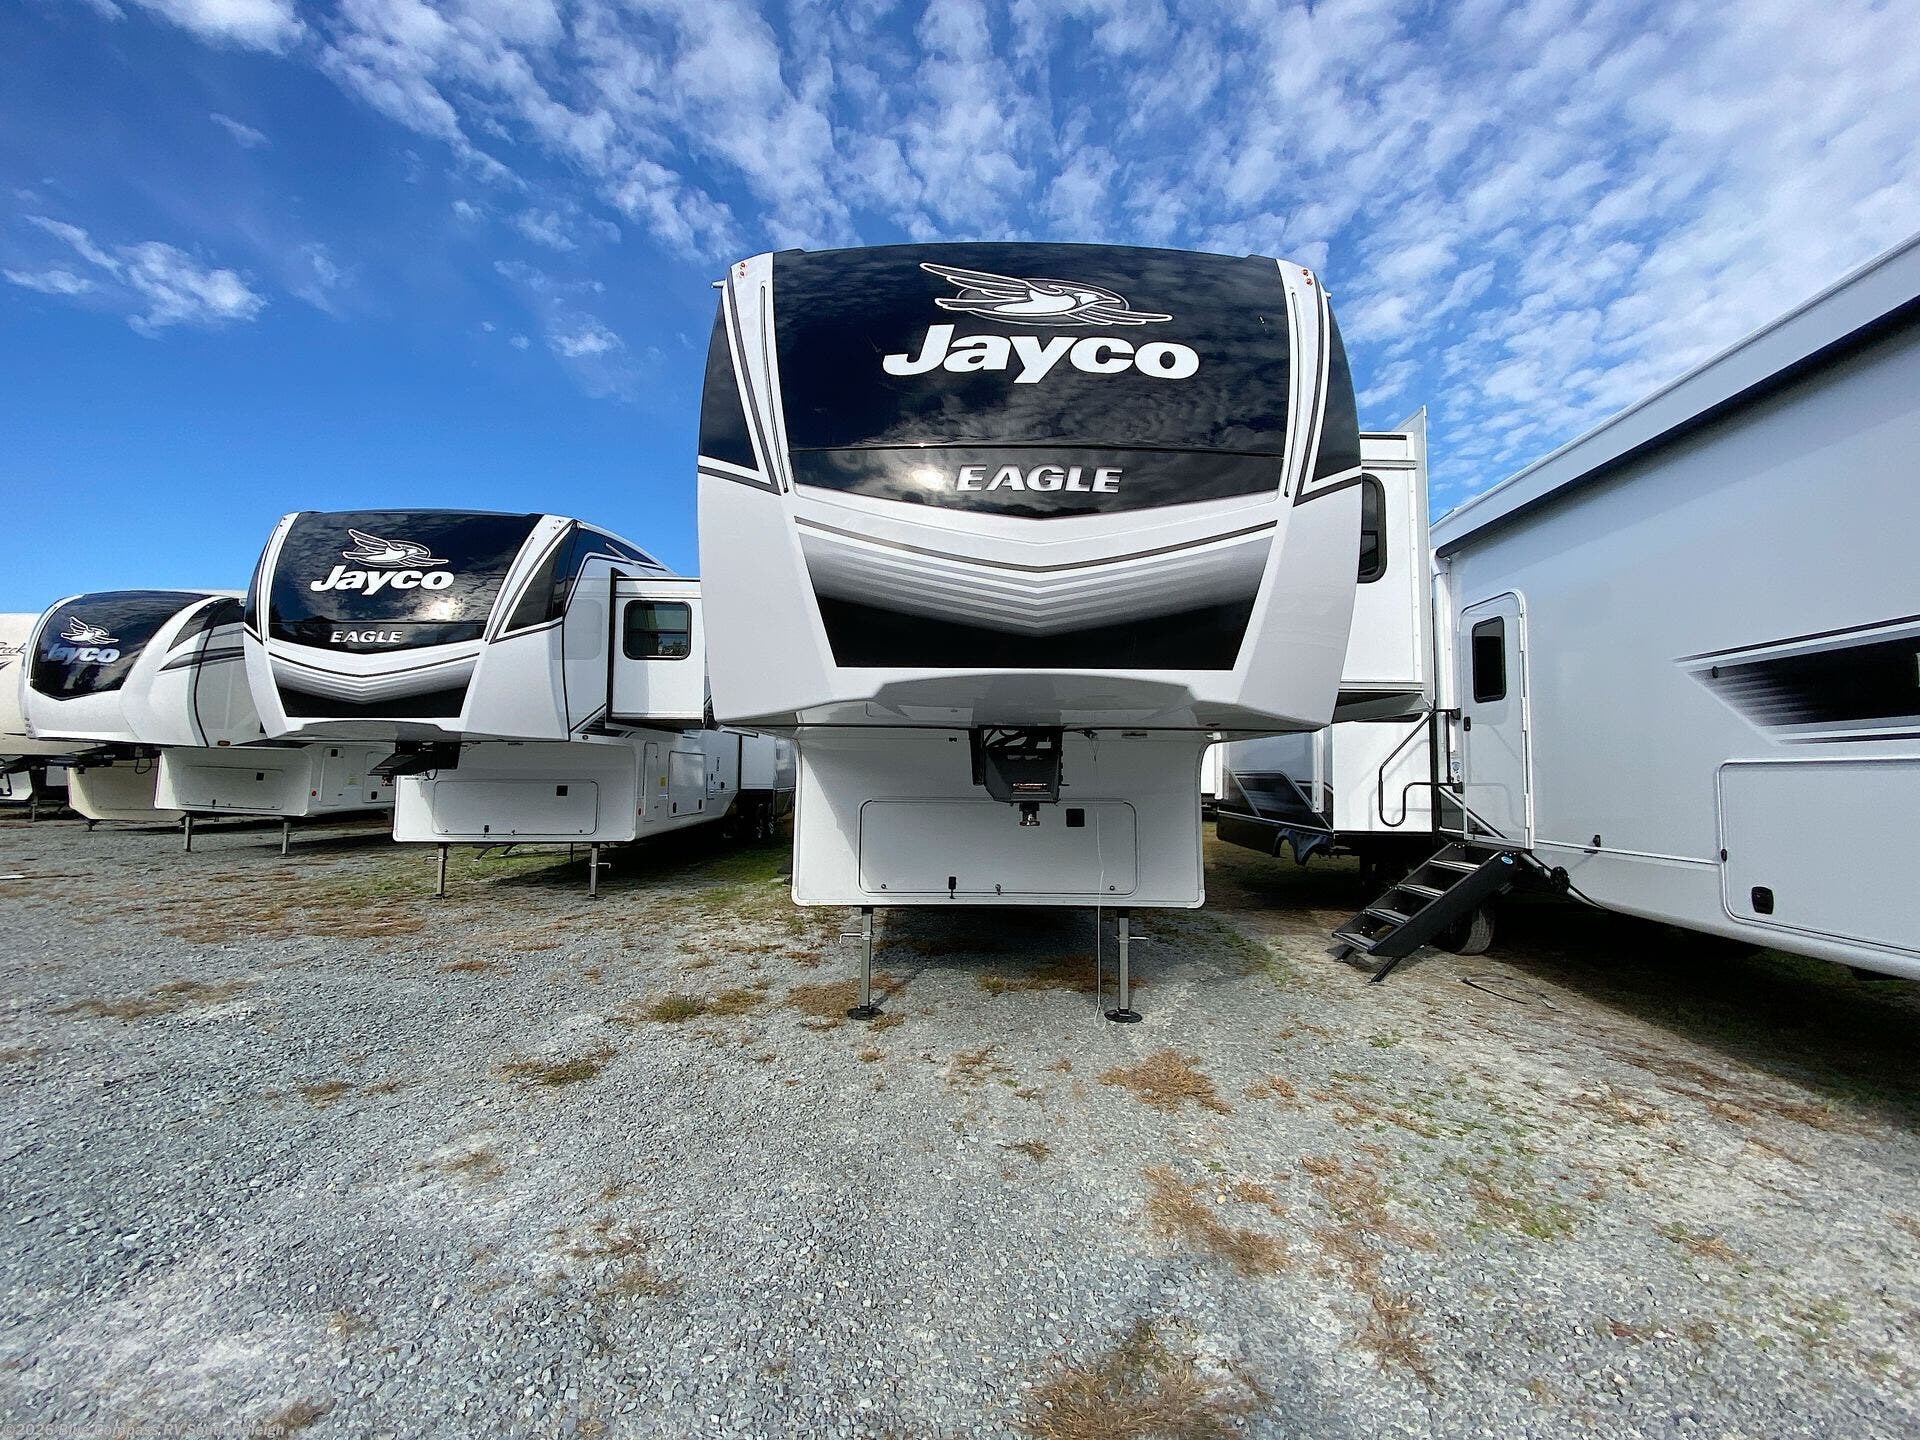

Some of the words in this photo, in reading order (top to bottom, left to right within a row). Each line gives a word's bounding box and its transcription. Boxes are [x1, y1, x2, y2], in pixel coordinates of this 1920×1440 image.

[882, 324, 1200, 384] Jayco
[956, 464, 1124, 493] EAGLE
[310, 565, 455, 596] Jayco
[330, 630, 403, 643] EAGLE
[41, 643, 120, 665] Jayco
